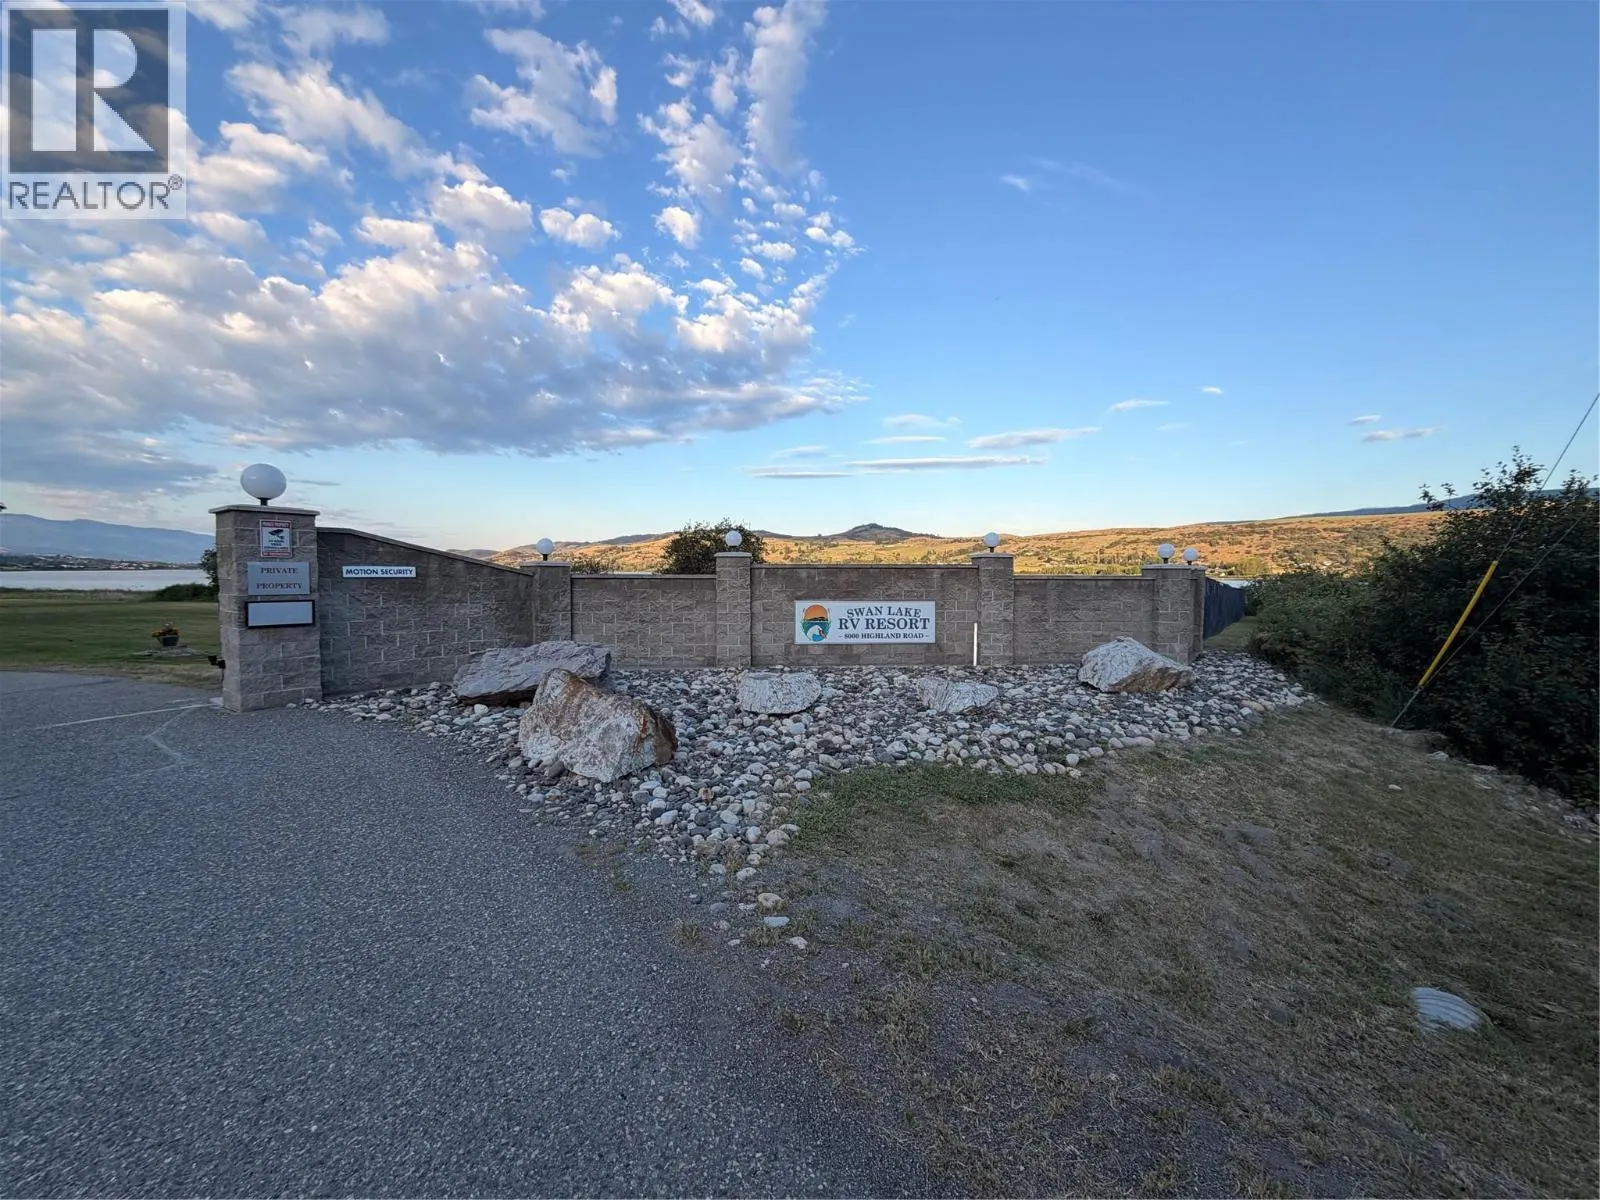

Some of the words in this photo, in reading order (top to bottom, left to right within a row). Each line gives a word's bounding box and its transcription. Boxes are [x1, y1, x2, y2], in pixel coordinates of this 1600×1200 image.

[260, 567, 299, 575] PRIVATE
[256, 582, 303, 590] PROPERTY
[846, 606, 883, 618] SWAN
[887, 606, 921, 618] LAKE
[838, 618, 860, 630] RV
[865, 618, 930, 630] RESORT
